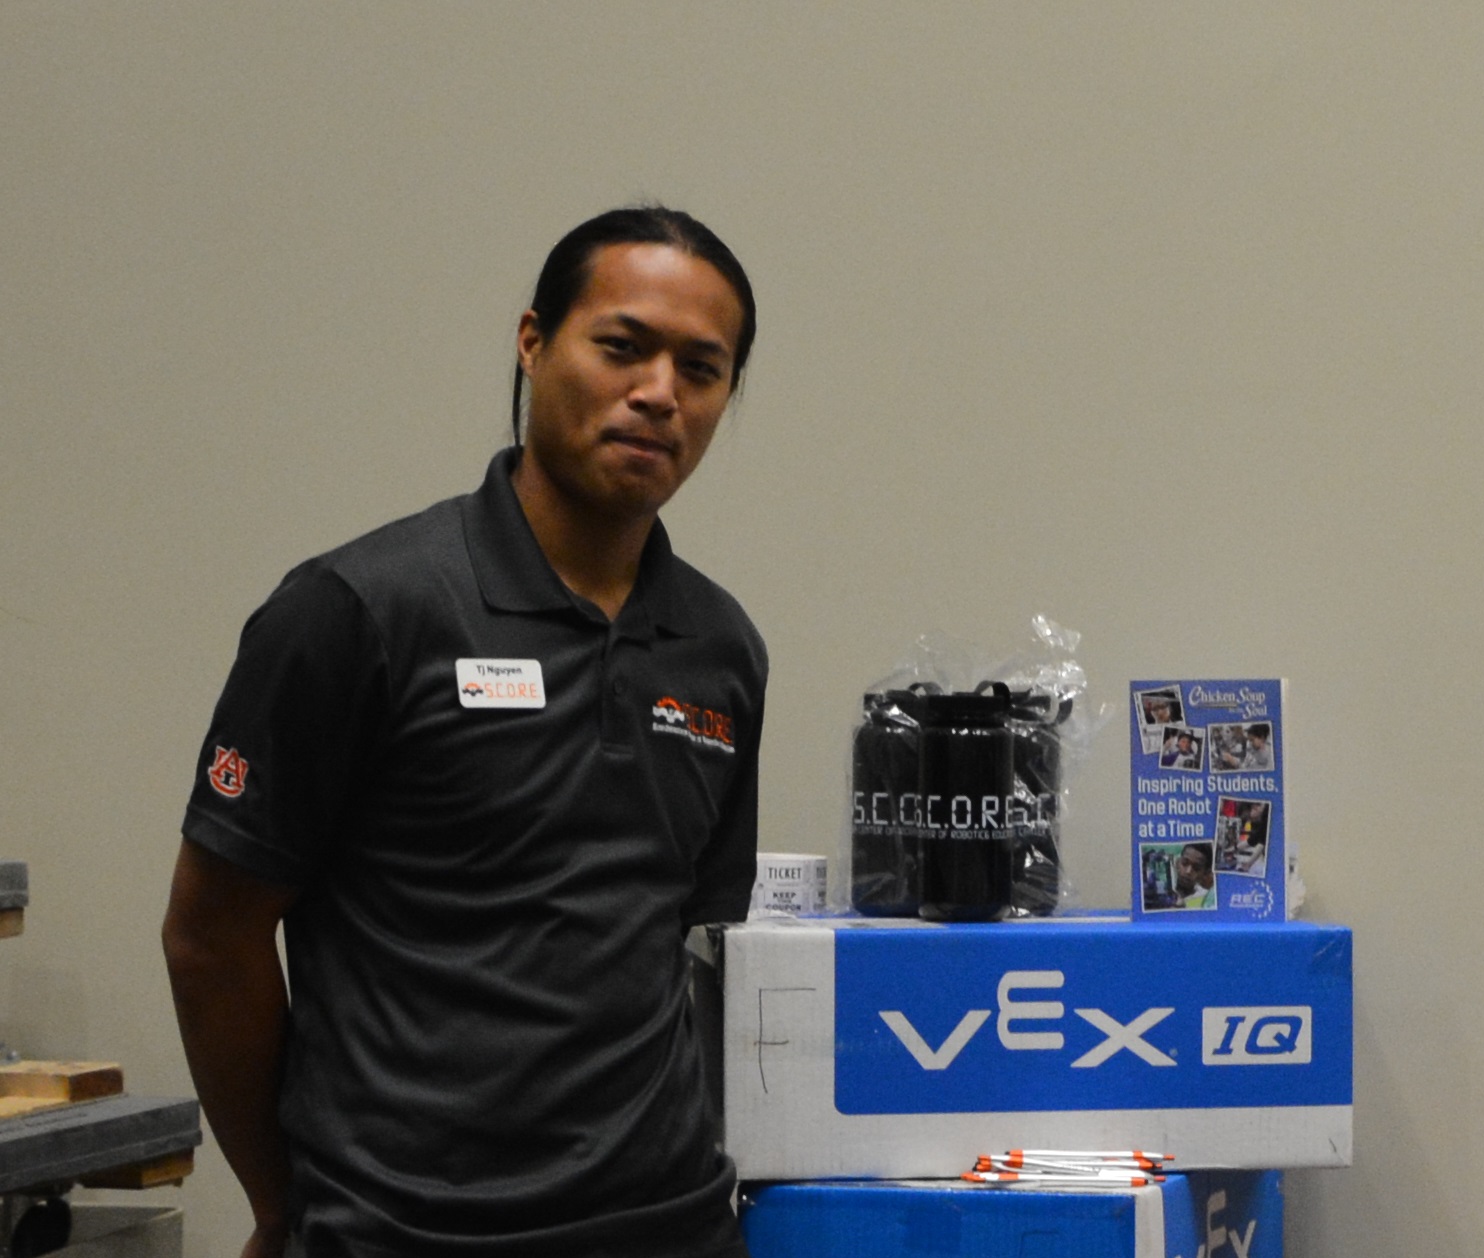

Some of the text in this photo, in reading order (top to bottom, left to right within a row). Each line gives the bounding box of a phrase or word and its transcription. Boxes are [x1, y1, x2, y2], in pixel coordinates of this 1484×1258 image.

[487, 665, 522, 676] Nguyen
[1188, 685, 1236, 706] Chicken
[1138, 776, 1203, 795] Inspiring
[1138, 798, 1211, 815] One Robot
[1139, 821, 1204, 837] at a Time
[768, 867, 802, 879] TICKET
[879, 971, 1304, 1070] VEX IQ
